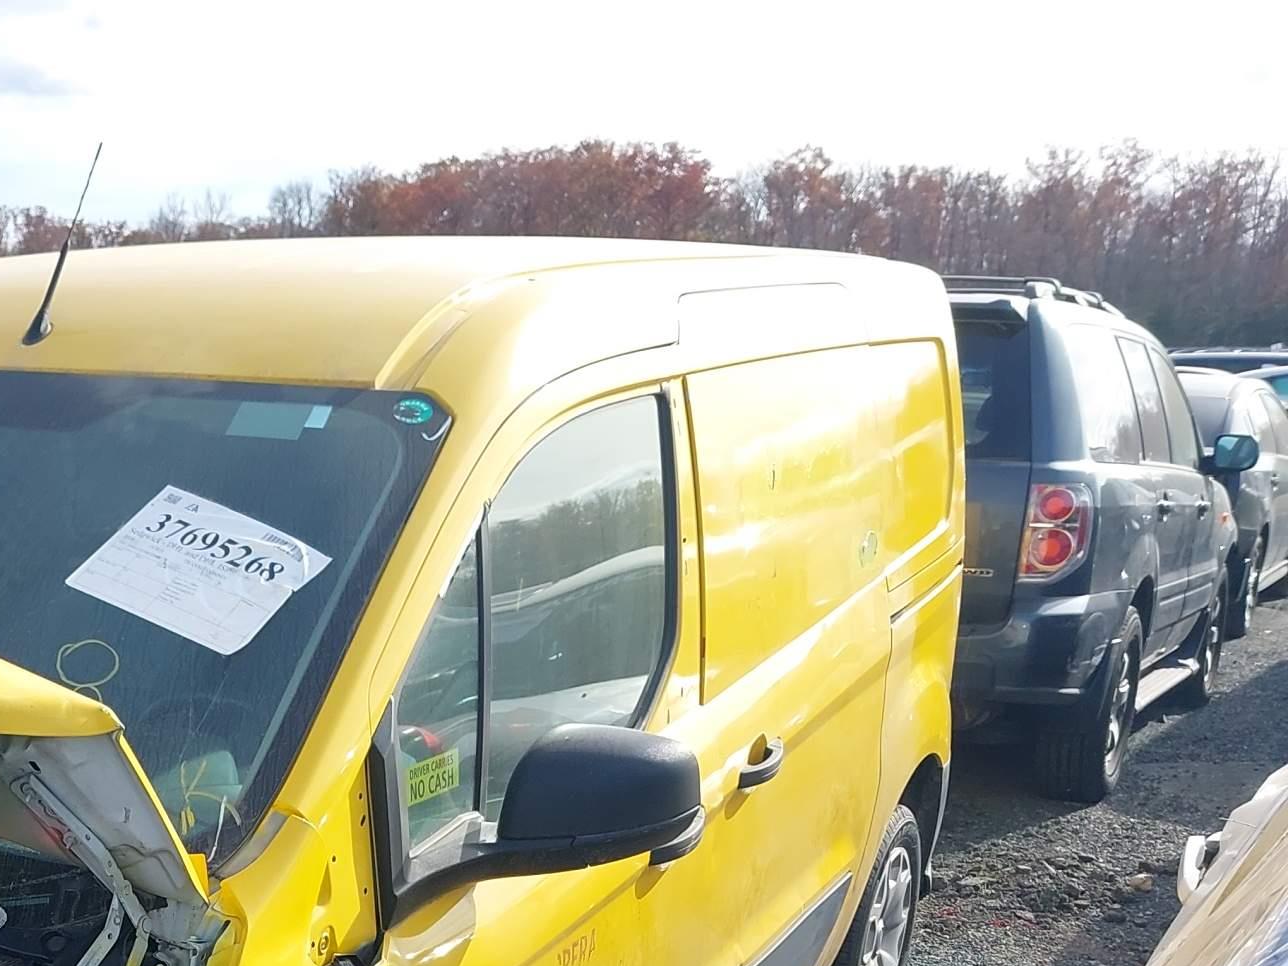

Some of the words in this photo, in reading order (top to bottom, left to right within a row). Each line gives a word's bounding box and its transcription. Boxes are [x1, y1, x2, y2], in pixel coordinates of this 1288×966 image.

[145, 513, 285, 582] 37695268
[962, 567, 994, 577] WD
[409, 762, 430, 780] DRIVER
[409, 779, 425, 802] NO
[428, 767, 454, 793] CASH
